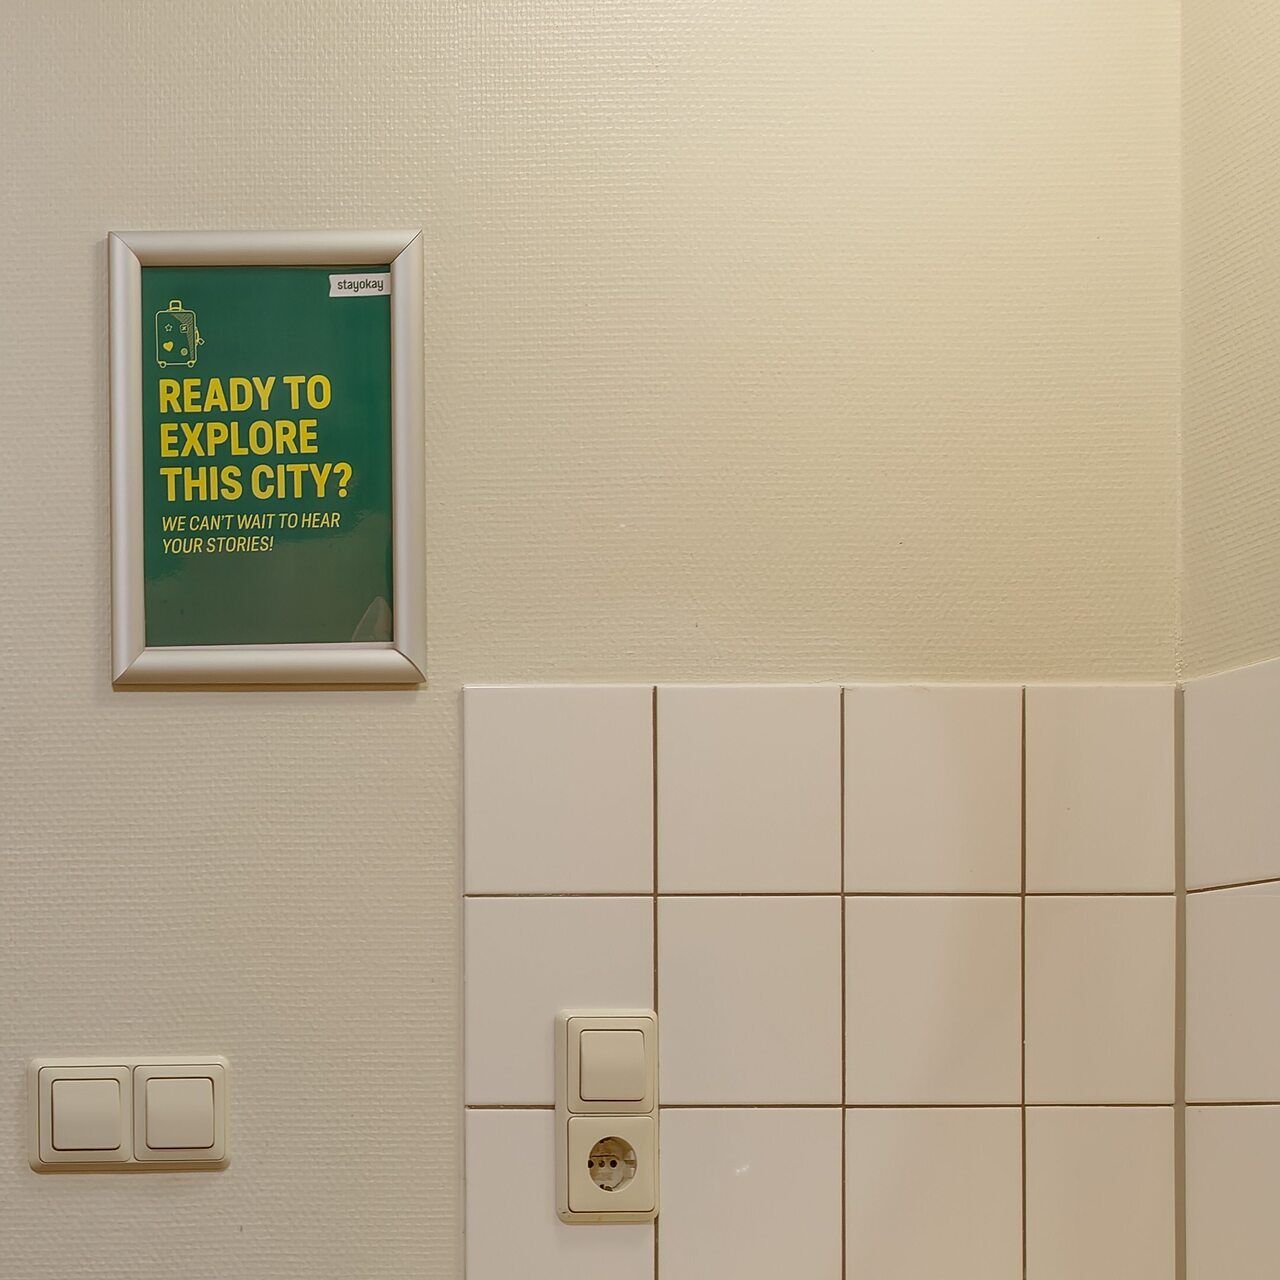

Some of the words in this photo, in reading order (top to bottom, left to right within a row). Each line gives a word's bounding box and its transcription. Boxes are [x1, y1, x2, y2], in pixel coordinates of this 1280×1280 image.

[337, 278, 384, 292] stayokay
[159, 376, 276, 413] READY
[283, 374, 332, 410] TO
[160, 419, 318, 457] EXPLORE
[159, 465, 243, 502] THIS
[251, 462, 353, 500] CITY?
[162, 516, 186, 532] WE
[189, 514, 234, 531] CAN'T
[237, 513, 276, 530] WAIT
[279, 513, 298, 529] TO
[301, 512, 340, 528] HEAR
[162, 537, 202, 554] YOUR
[206, 535, 274, 553] STORIES!
